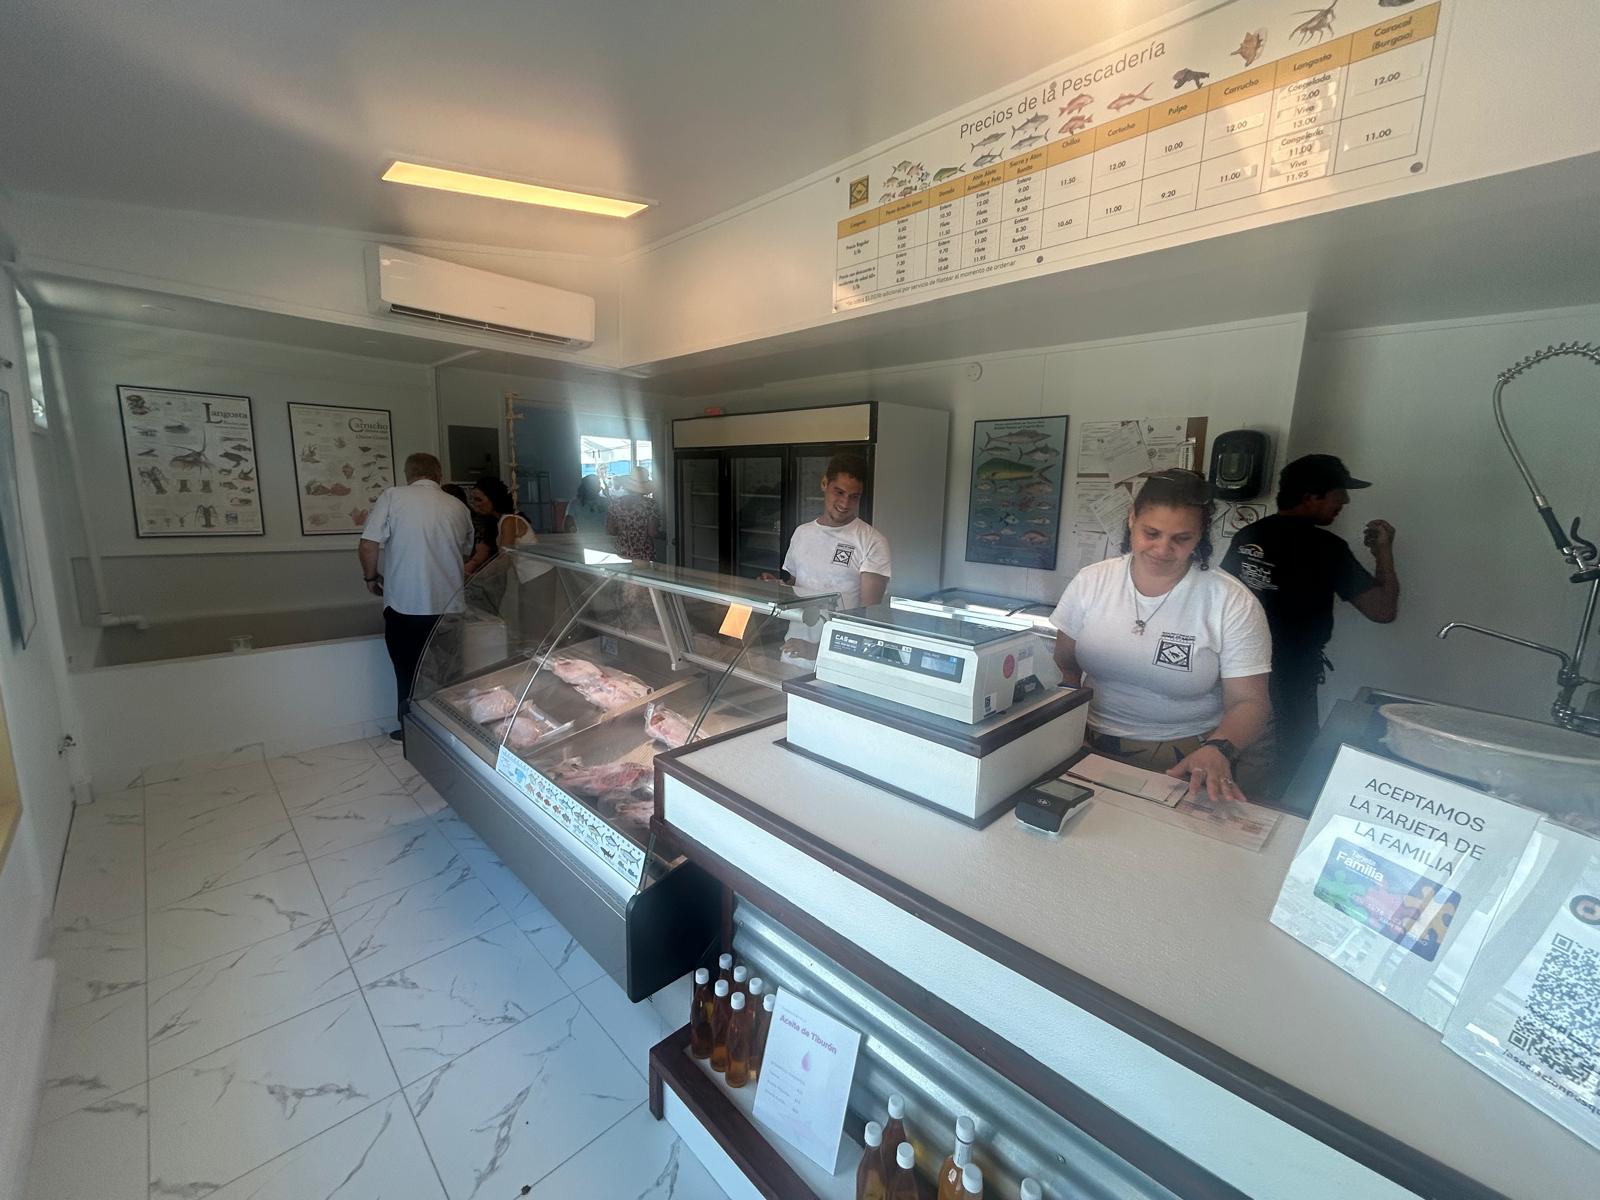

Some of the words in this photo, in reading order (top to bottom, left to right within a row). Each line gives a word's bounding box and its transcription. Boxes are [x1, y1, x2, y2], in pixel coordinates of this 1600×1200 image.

[1374, 16, 1413, 37] Caracol
[1372, 30, 1413, 50] (Burgao)
[1293, 53, 1332, 71] Langosta
[1374, 72, 1400, 87] 12.00
[960, 111, 1013, 139] Precios
[1018, 96, 1037, 115] de
[1042, 89, 1056, 105] la
[1062, 41, 1166, 97] Pescadería
[1224, 79, 1260, 95] Carrucho
[1297, 89, 1320, 102] 12.00
[1168, 103, 1188, 116] Pulpo
[1296, 105, 1315, 114] Viva
[1226, 120, 1248, 133] 12.00
[1293, 116, 1317, 129] 13.00
[1108, 122, 1136, 137] Cartucho
[1365, 128, 1392, 142] 11.00
[1165, 141, 1184, 153] 10.00
[1289, 144, 1312, 157] 11.00
[1109, 160, 1127, 171] 12.00
[1290, 160, 1307, 169] Viva
[1060, 176, 1076, 187] 11.50
[1220, 172, 1241, 183] 11.00
[1286, 171, 1309, 182] 11.95
[1161, 189, 1176, 200] 9.20
[1105, 204, 1122, 215] 11.00
[1057, 218, 1073, 228] 10.60
[1015, 245, 1026, 253] 8.70
[202, 402, 248, 424] Langosta
[1365, 778, 1486, 832] ACEPTAMOS
[1350, 795, 1370, 814] LA
[1375, 804, 1449, 847] TARJETA
[1455, 838, 1487, 860] DE
[1355, 822, 1375, 841] LA
[1380, 833, 1455, 877] FAMILIA
[1336, 851, 1384, 882] Familia
[779, 1014, 800, 1031] Aceite
[801, 1026, 810, 1038] de
[811, 1031, 838, 1055] Tiburón
